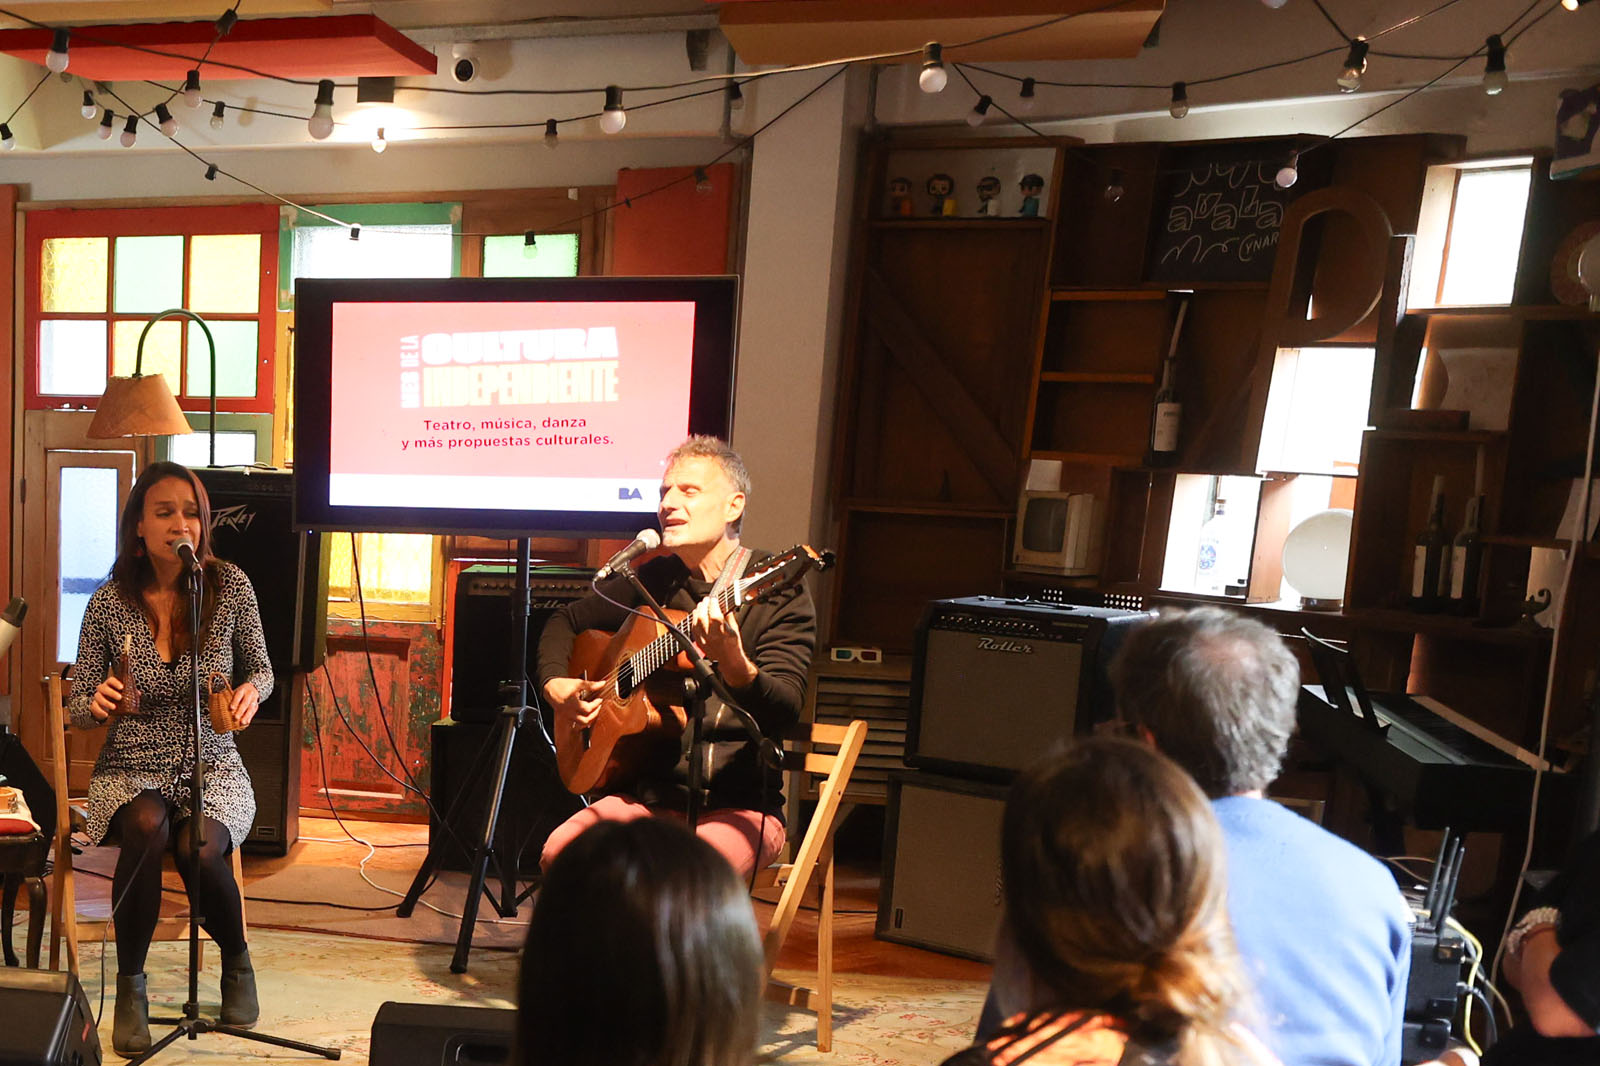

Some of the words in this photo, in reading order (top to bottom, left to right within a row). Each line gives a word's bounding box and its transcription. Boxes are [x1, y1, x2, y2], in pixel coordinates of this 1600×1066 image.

[421, 327, 619, 365] CULTURA
[423, 361, 619, 407] INDEPENDIENTE
[424, 420, 476, 431] Teatro,
[481, 417, 537, 430] música,
[542, 417, 587, 428] danza
[401, 439, 409, 450] y
[414, 436, 443, 448] más
[448, 436, 531, 450] propuestas
[535, 434, 614, 446] culturales.
[618, 487, 643, 500] BA
[977, 637, 1033, 654] Roller
